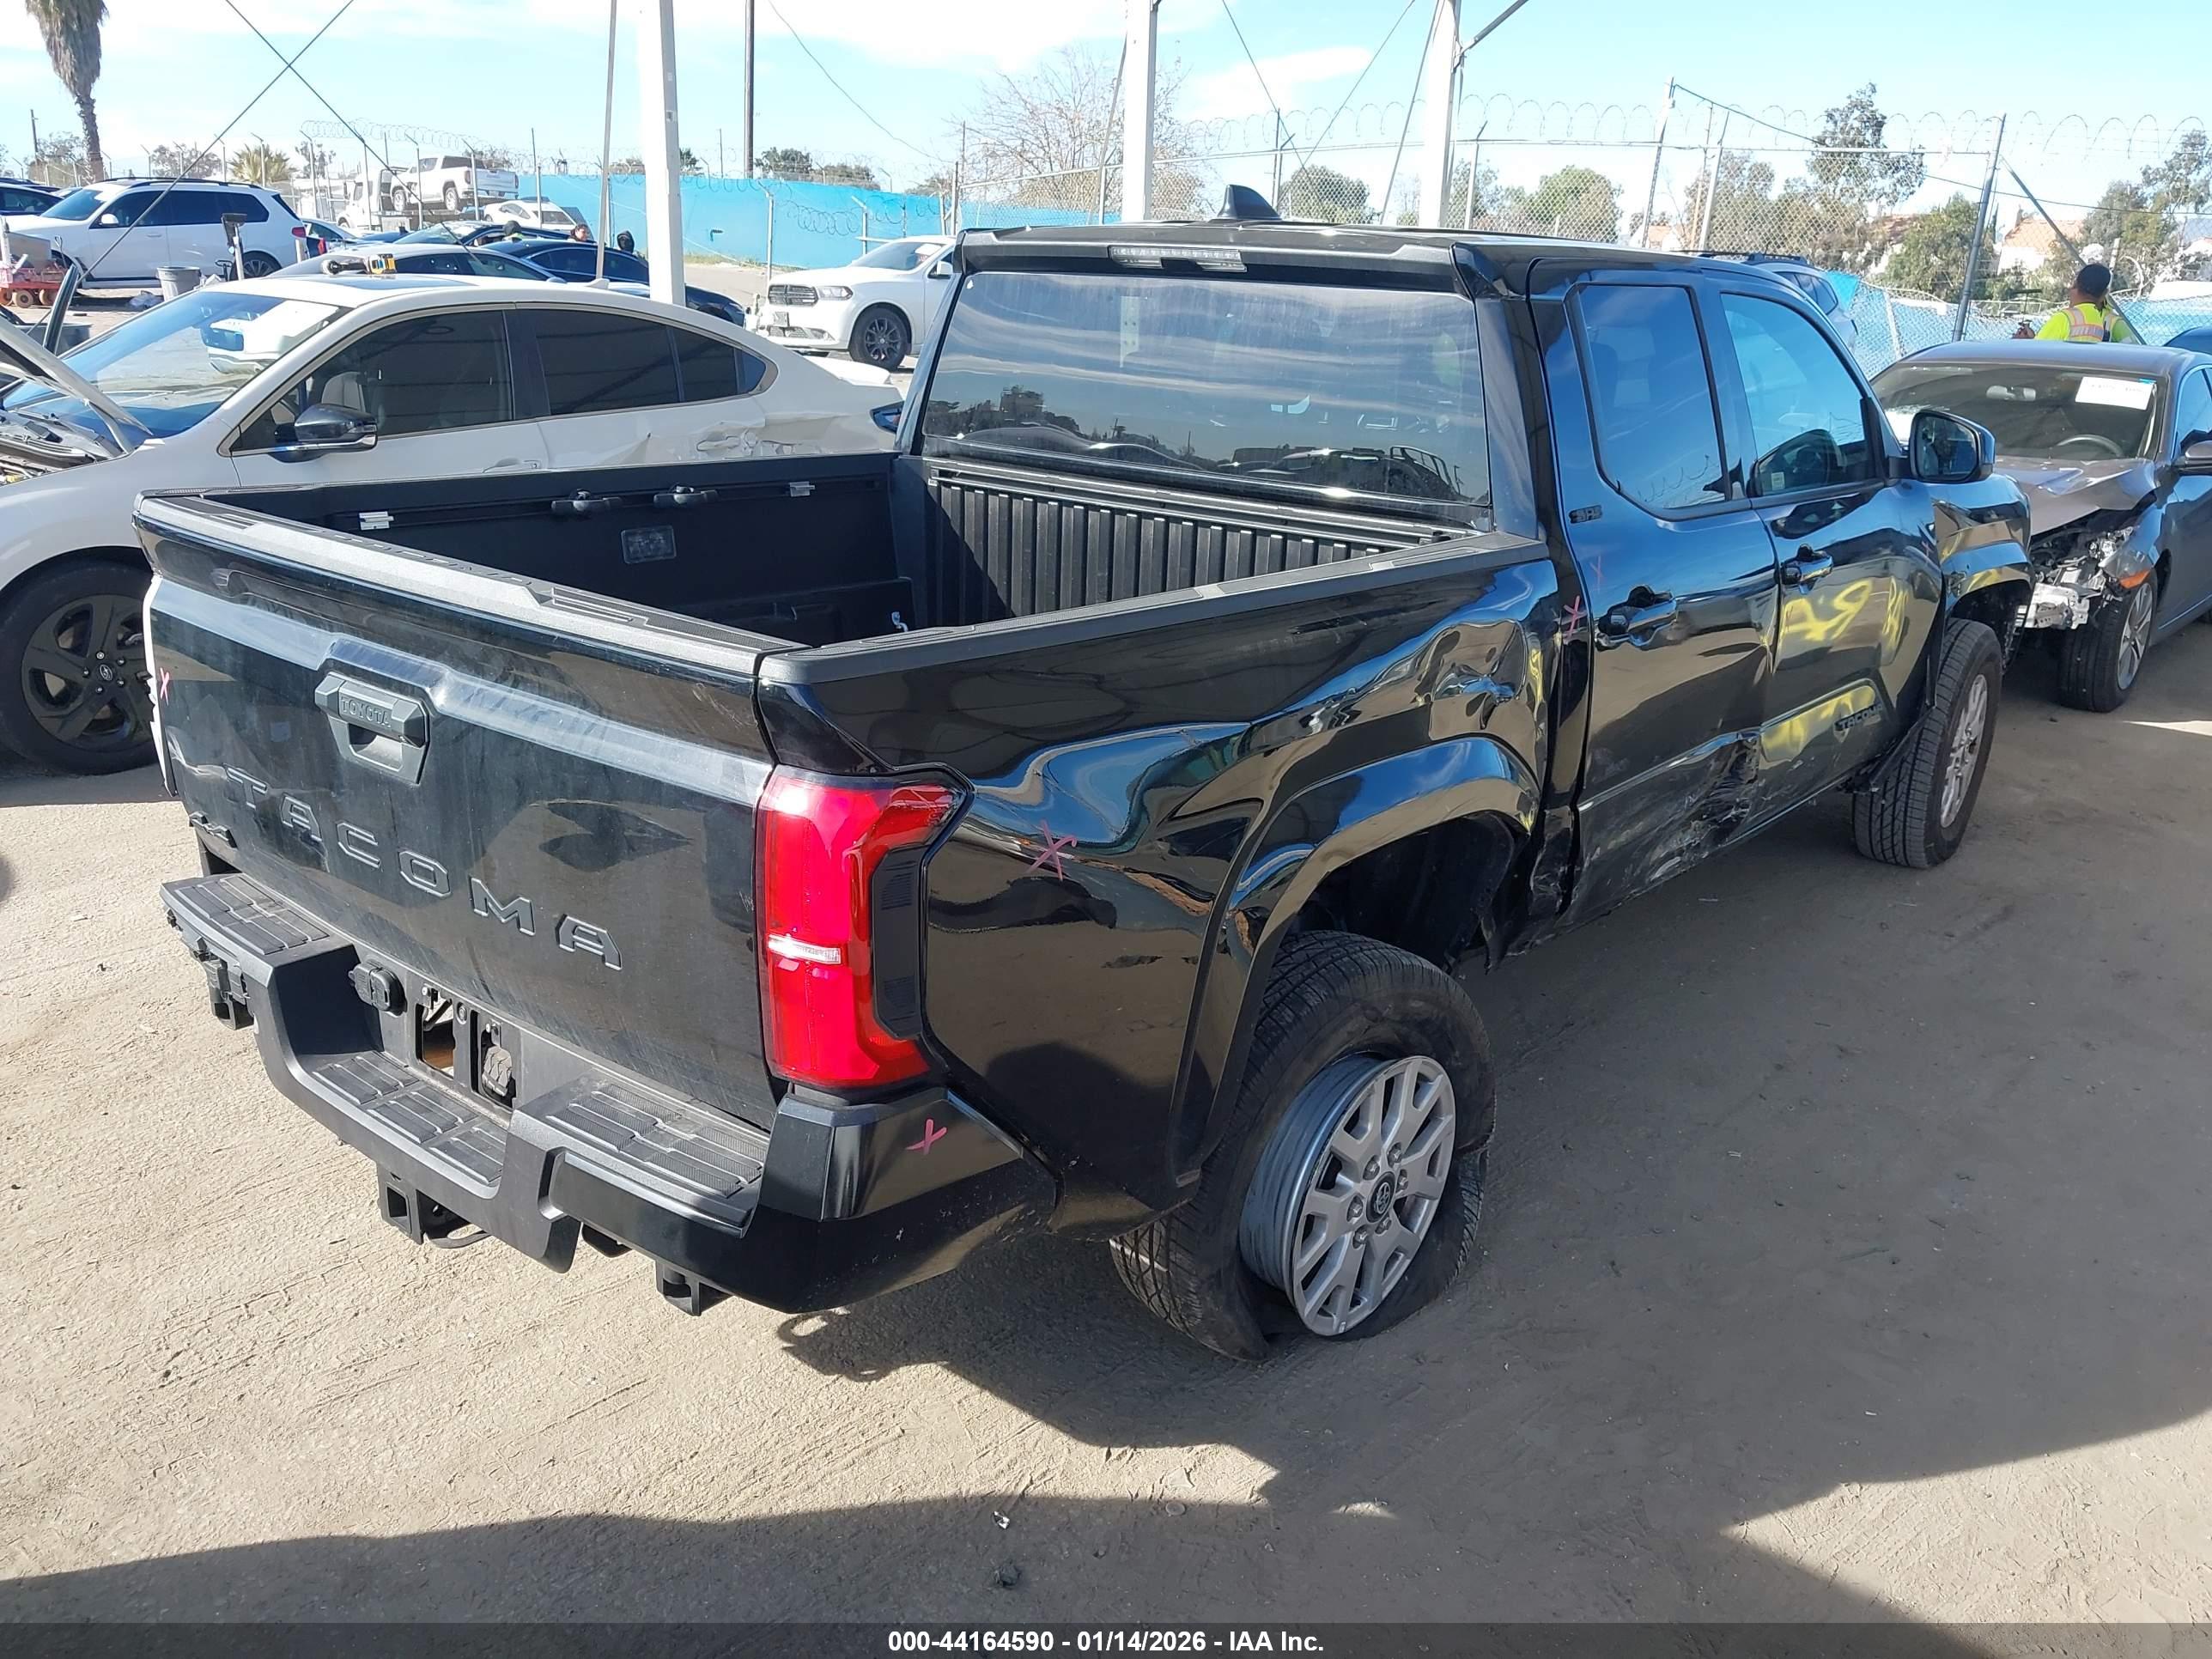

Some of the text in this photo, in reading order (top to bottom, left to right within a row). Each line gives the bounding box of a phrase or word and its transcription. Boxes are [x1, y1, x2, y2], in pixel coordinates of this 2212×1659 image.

[341, 696, 392, 728] TOYOTA
[1835, 702, 1884, 731] TACOMA
[223, 763, 623, 970] TACOMA
